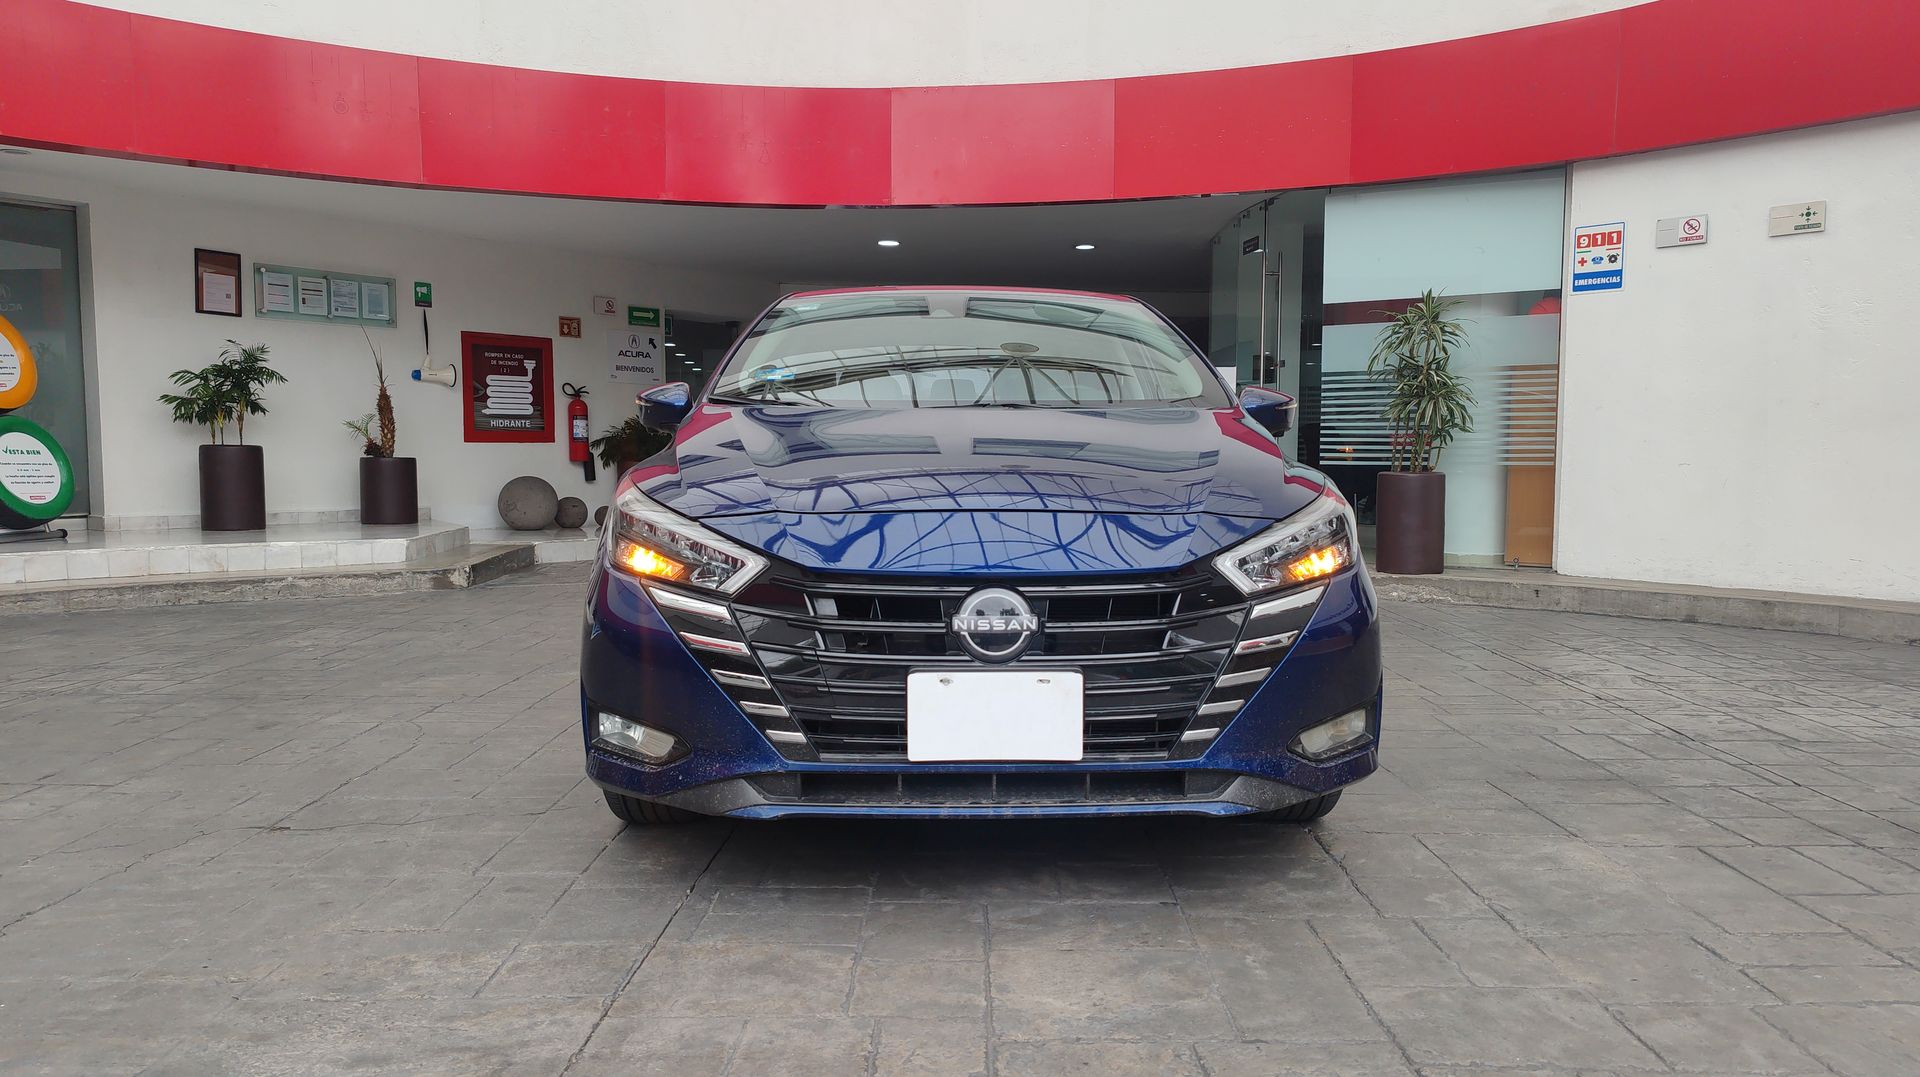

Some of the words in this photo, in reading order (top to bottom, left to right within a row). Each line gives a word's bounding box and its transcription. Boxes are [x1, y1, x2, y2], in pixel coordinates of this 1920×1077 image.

[1579, 232, 1618, 247] 911
[1574, 275, 1621, 287] EMERGENCIAS
[617, 350, 652, 359] ACURA
[615, 364, 655, 374] BIENVENIDOS
[490, 419, 531, 428] HIDRANTE
[954, 618, 1036, 631] NISSAN
